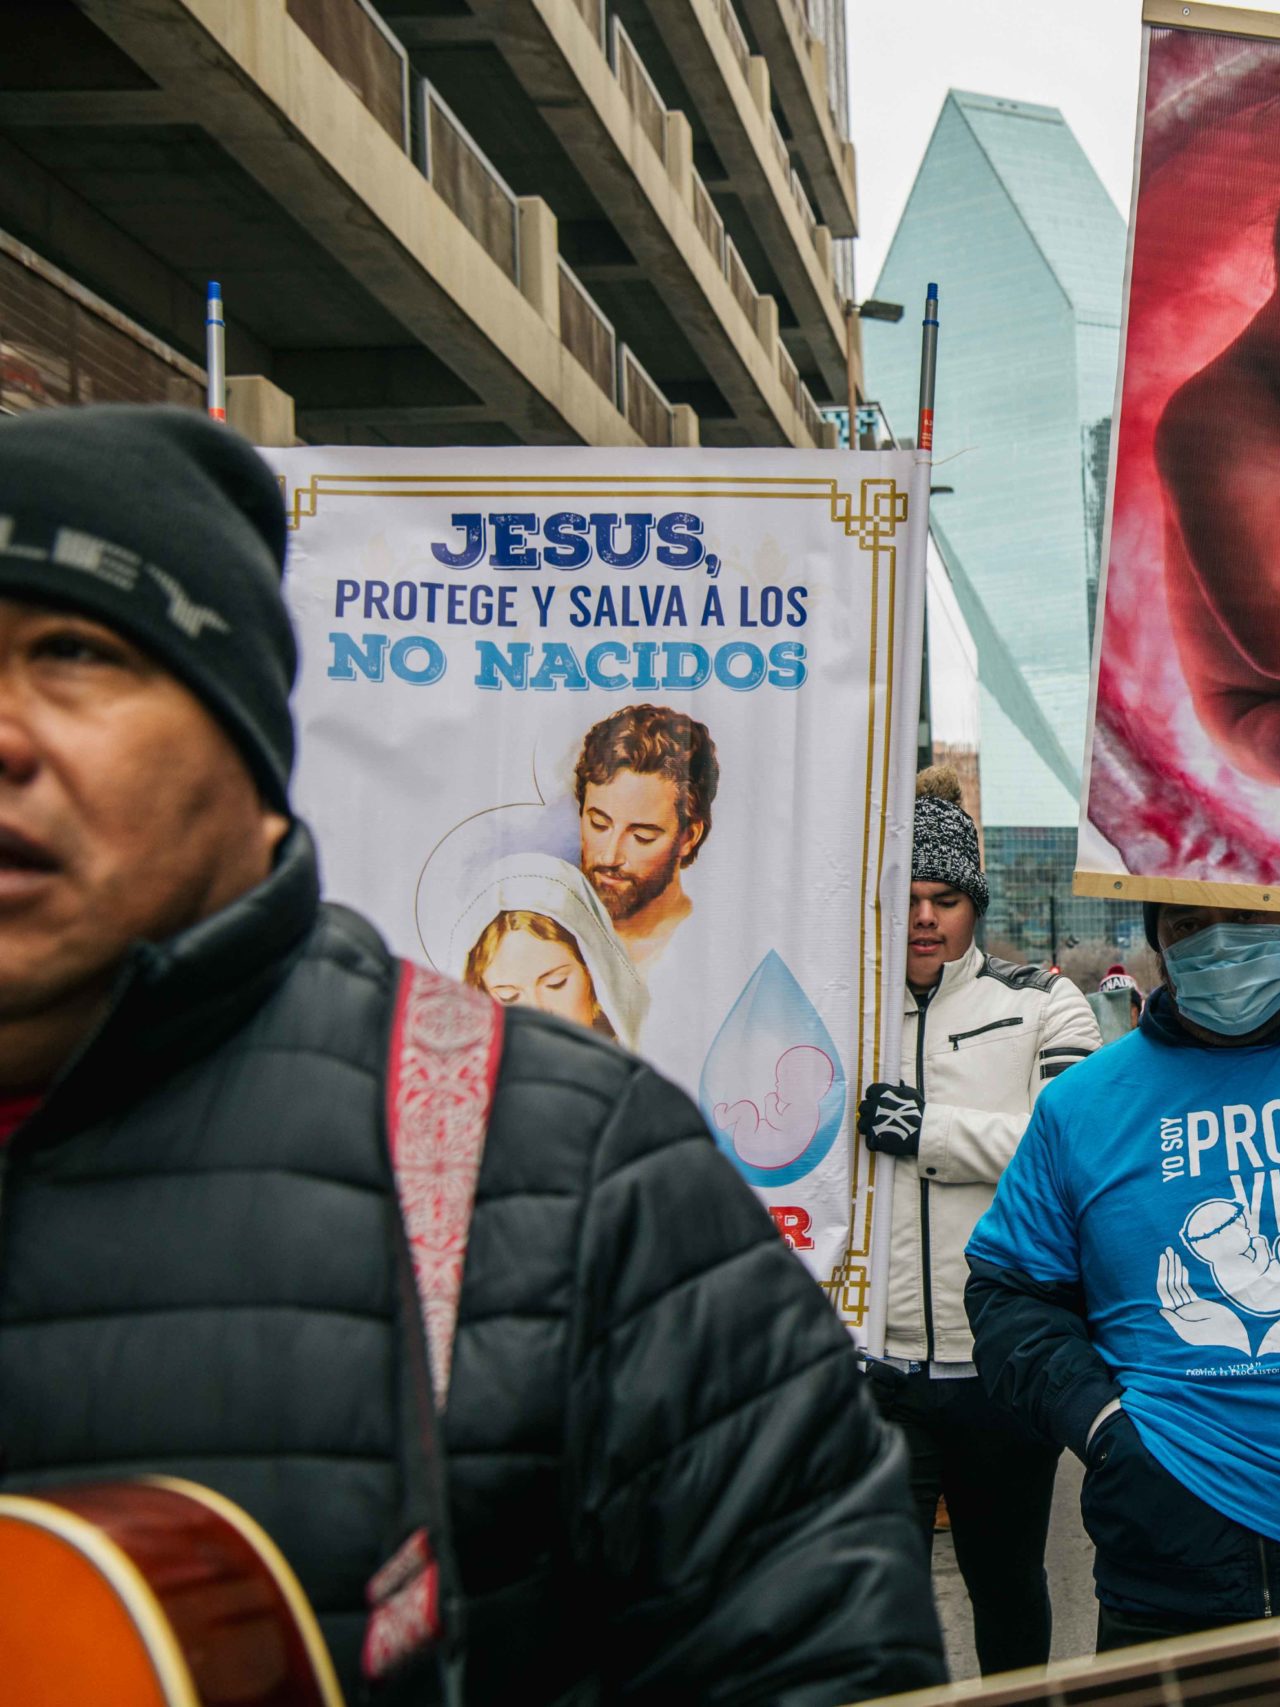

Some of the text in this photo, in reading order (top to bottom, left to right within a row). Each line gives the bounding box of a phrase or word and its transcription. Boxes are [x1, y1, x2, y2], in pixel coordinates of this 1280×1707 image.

[430, 511, 721, 577] JESUS,
[334, 579, 808, 628] PROTEGE Y SALVA A LOS
[327, 631, 808, 692] NO NACIDOS
[1160, 1117, 1185, 1183] YO SOY
